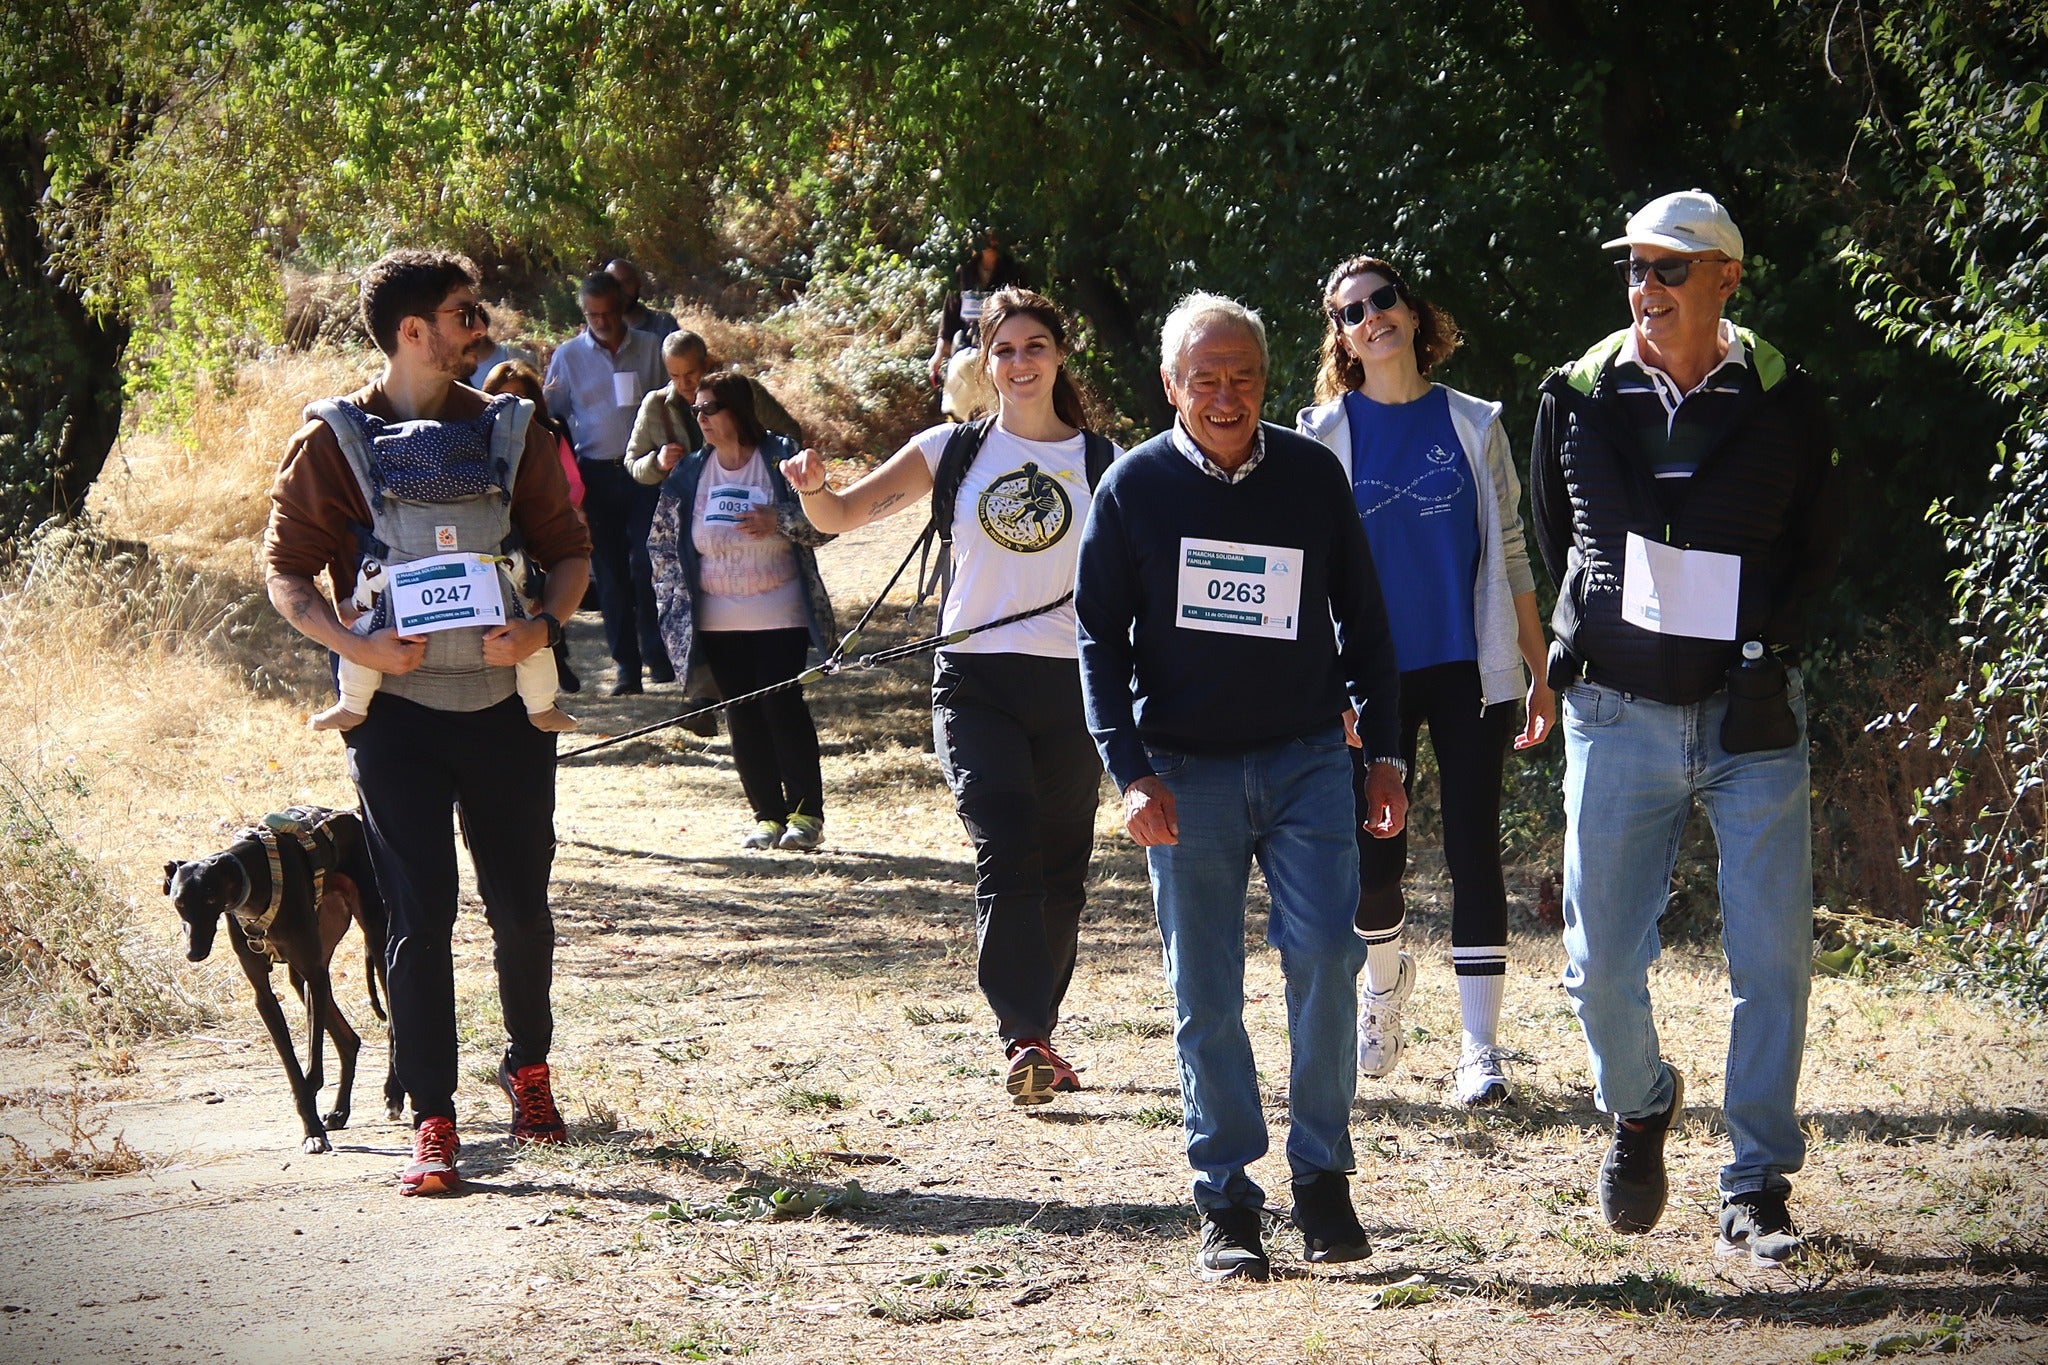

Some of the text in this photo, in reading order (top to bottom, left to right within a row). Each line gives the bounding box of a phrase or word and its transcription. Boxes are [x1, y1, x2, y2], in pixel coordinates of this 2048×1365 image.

[719, 501, 749, 513] 0033
[983, 520, 990, 528] tu
[1192, 550, 1215, 558] MARCHA
[1216, 553, 1244, 561] SOLIDARIA
[401, 570, 421, 578] MARCHA
[421, 566, 446, 574] SOLIDARIA
[421, 584, 471, 606] 0247
[1207, 579, 1266, 604] 0263
[1217, 612, 1238, 620] OCTUBRE
